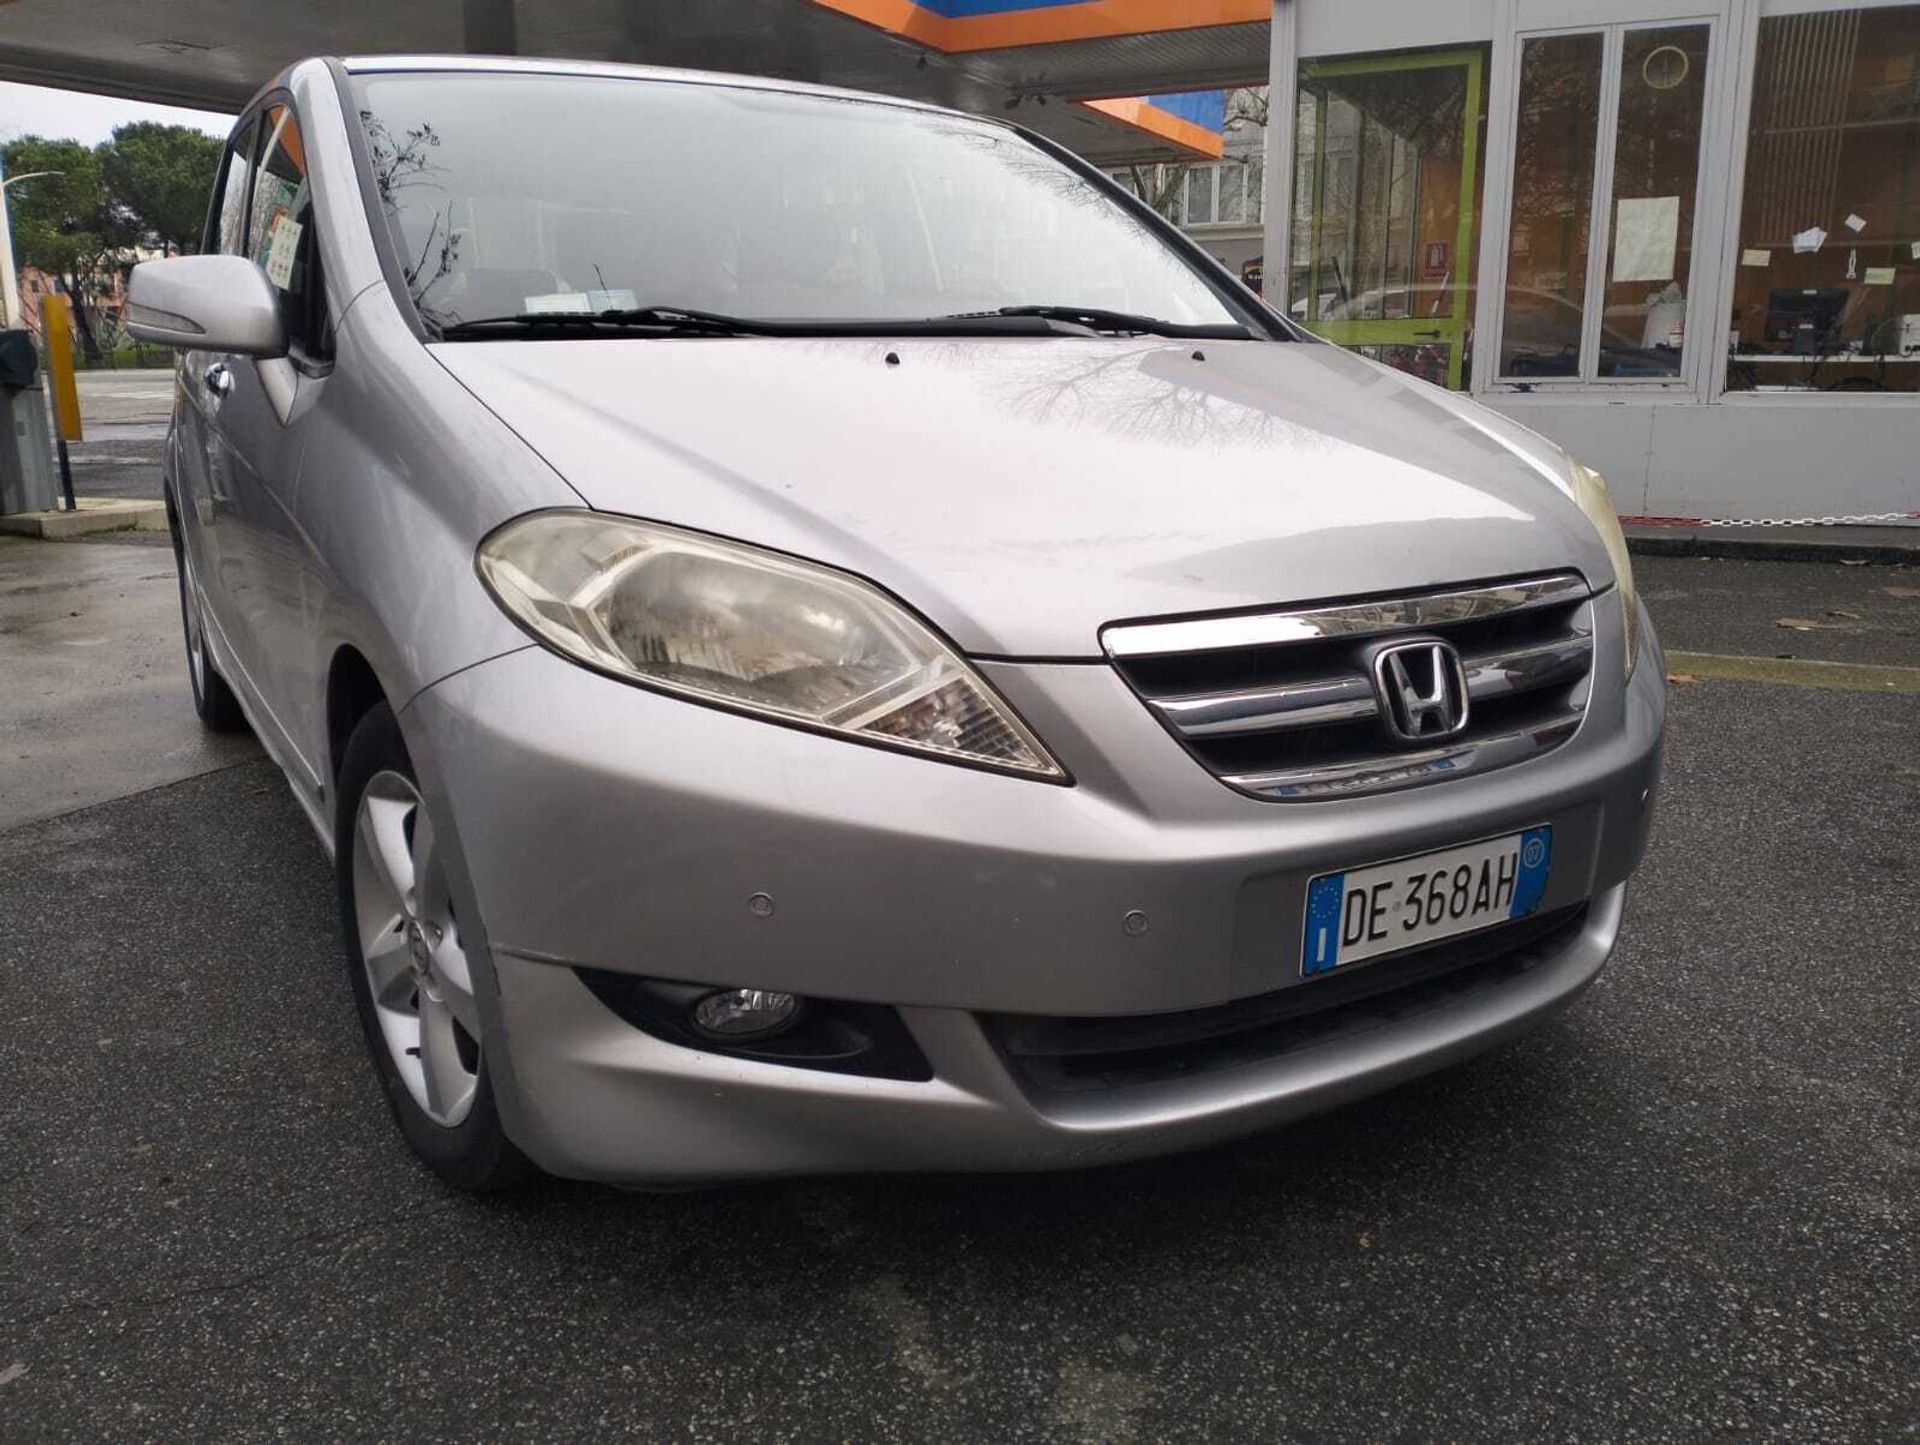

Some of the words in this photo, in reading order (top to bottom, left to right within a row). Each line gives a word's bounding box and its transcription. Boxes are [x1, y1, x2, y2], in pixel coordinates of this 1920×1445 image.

[1342, 881, 1393, 947] DE
[1402, 852, 1518, 931] 368AH
[1316, 927, 1327, 962] I
